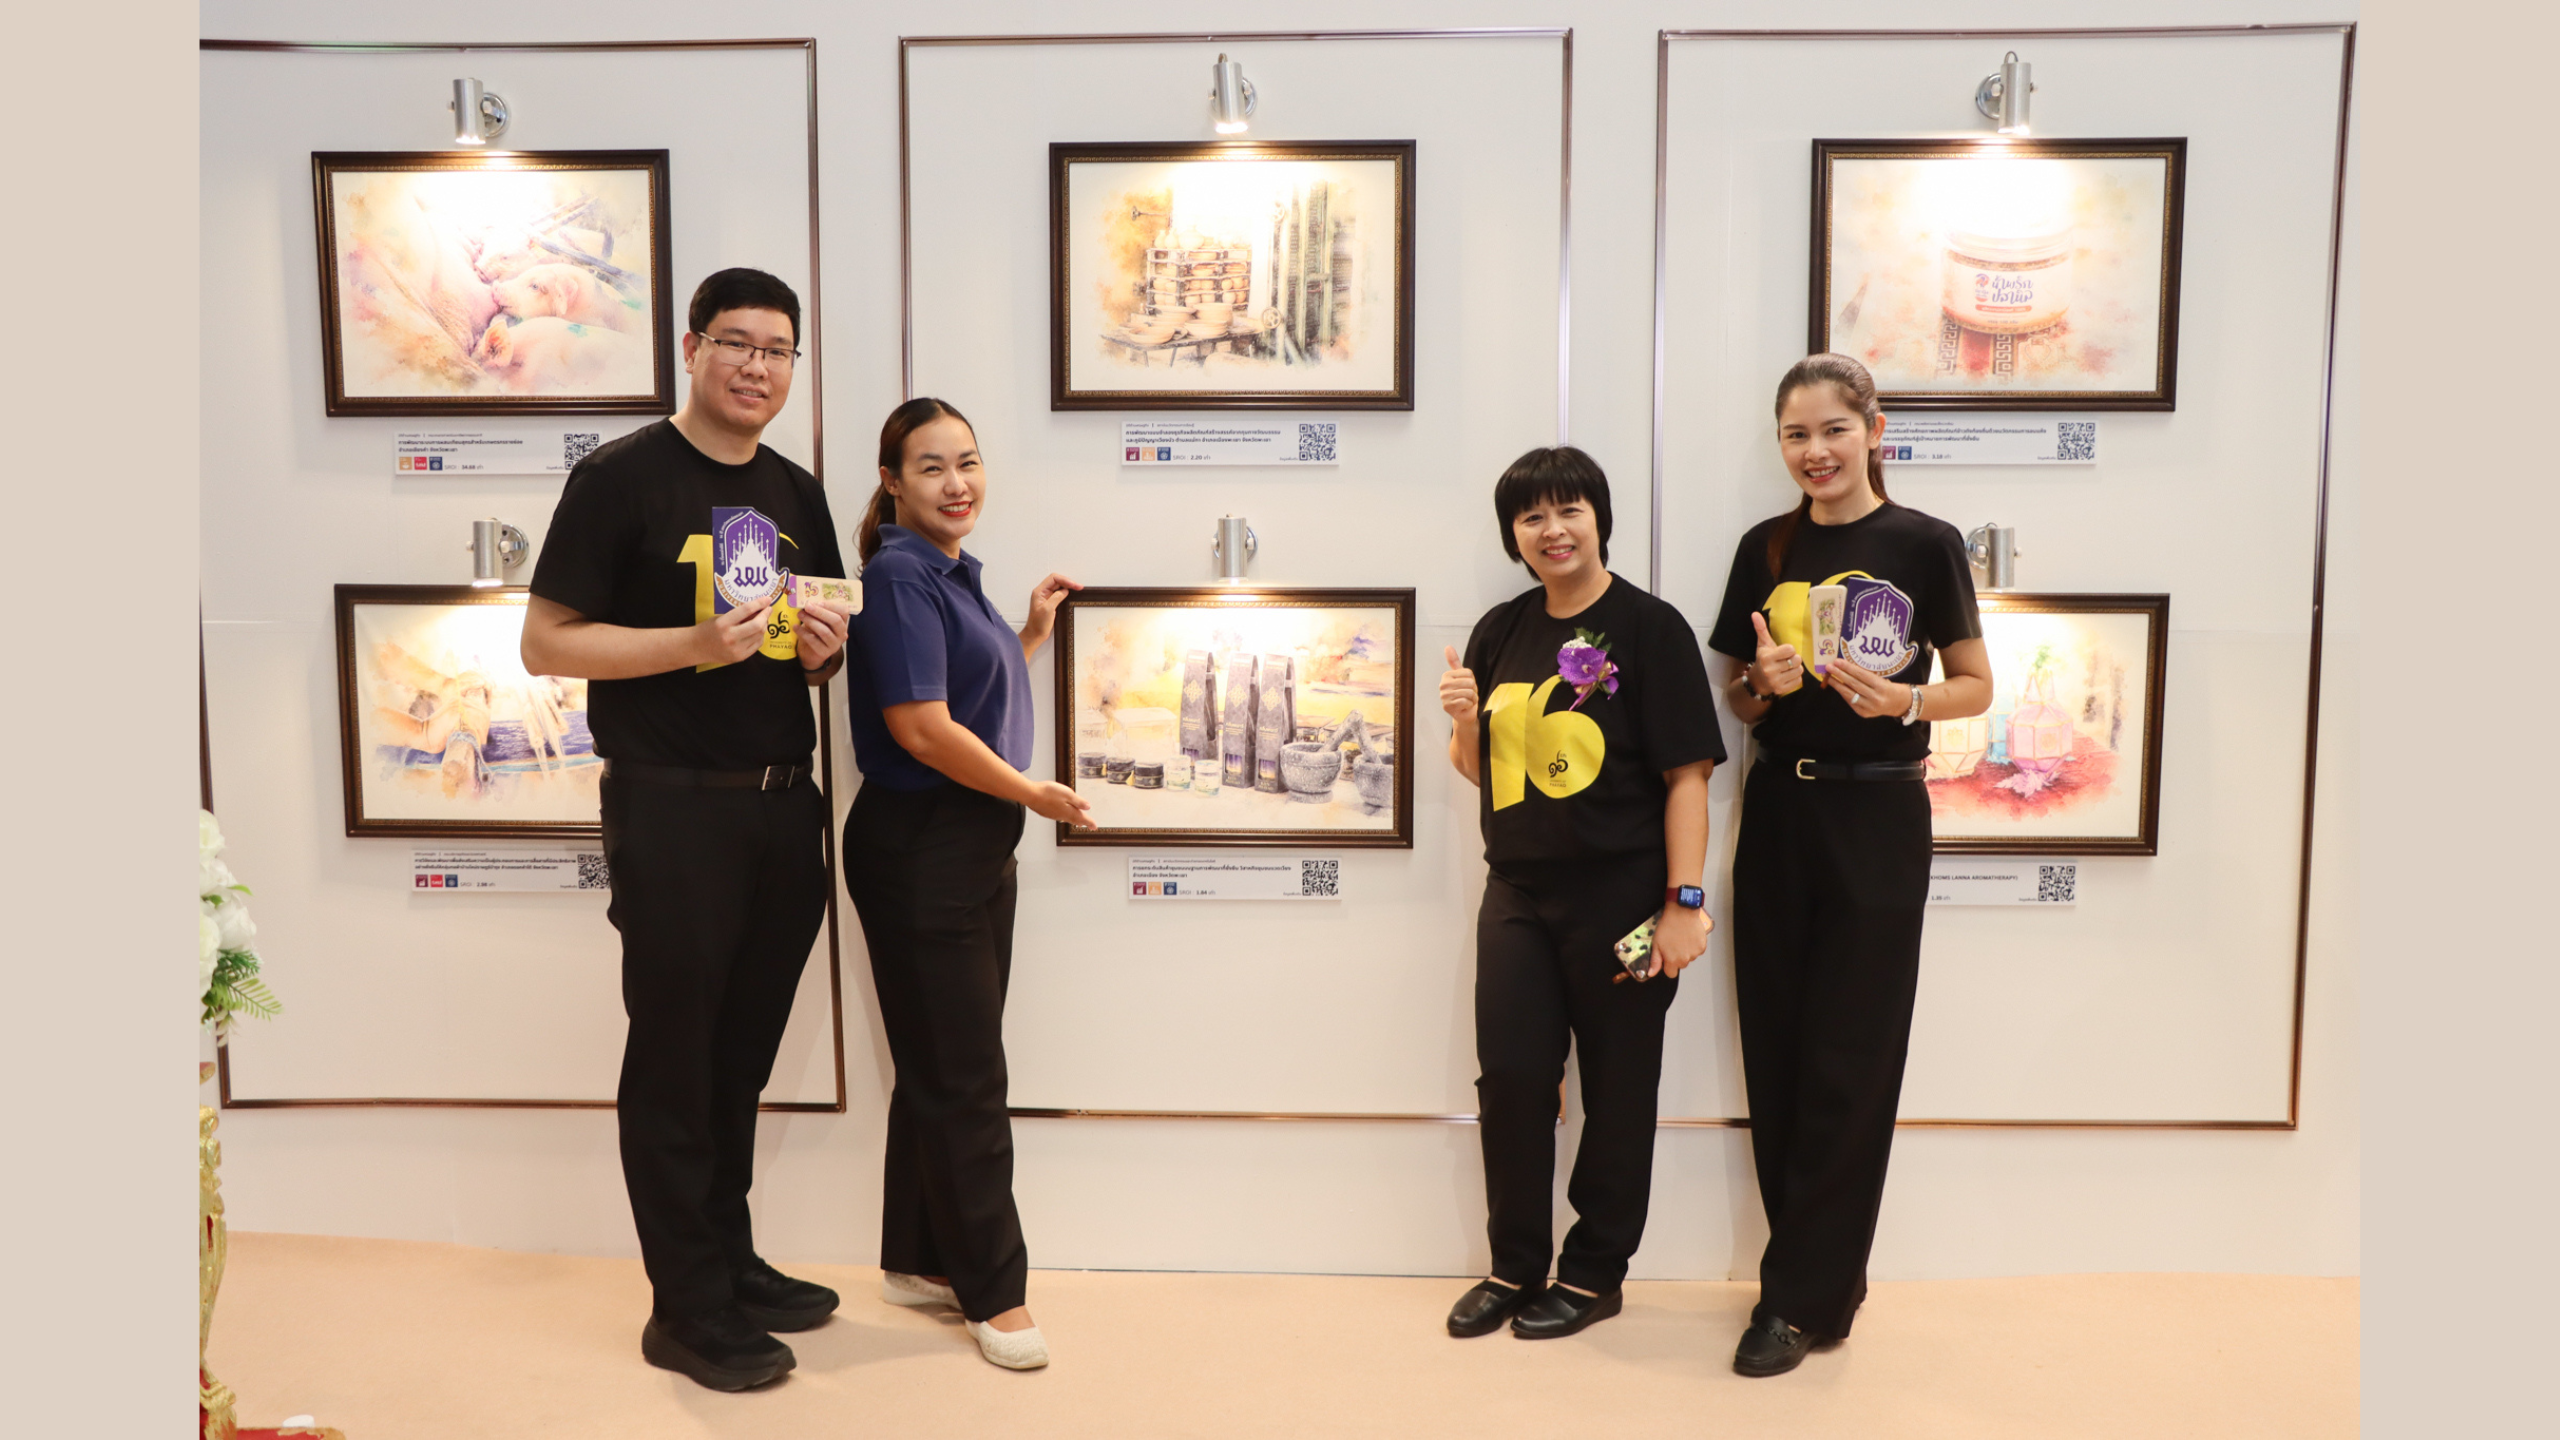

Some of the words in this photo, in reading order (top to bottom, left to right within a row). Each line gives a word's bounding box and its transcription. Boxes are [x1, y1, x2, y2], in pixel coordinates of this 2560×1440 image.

[1991, 274, 2034, 290] น้ำพริก
[1991, 289, 2033, 304] ปลานิล
